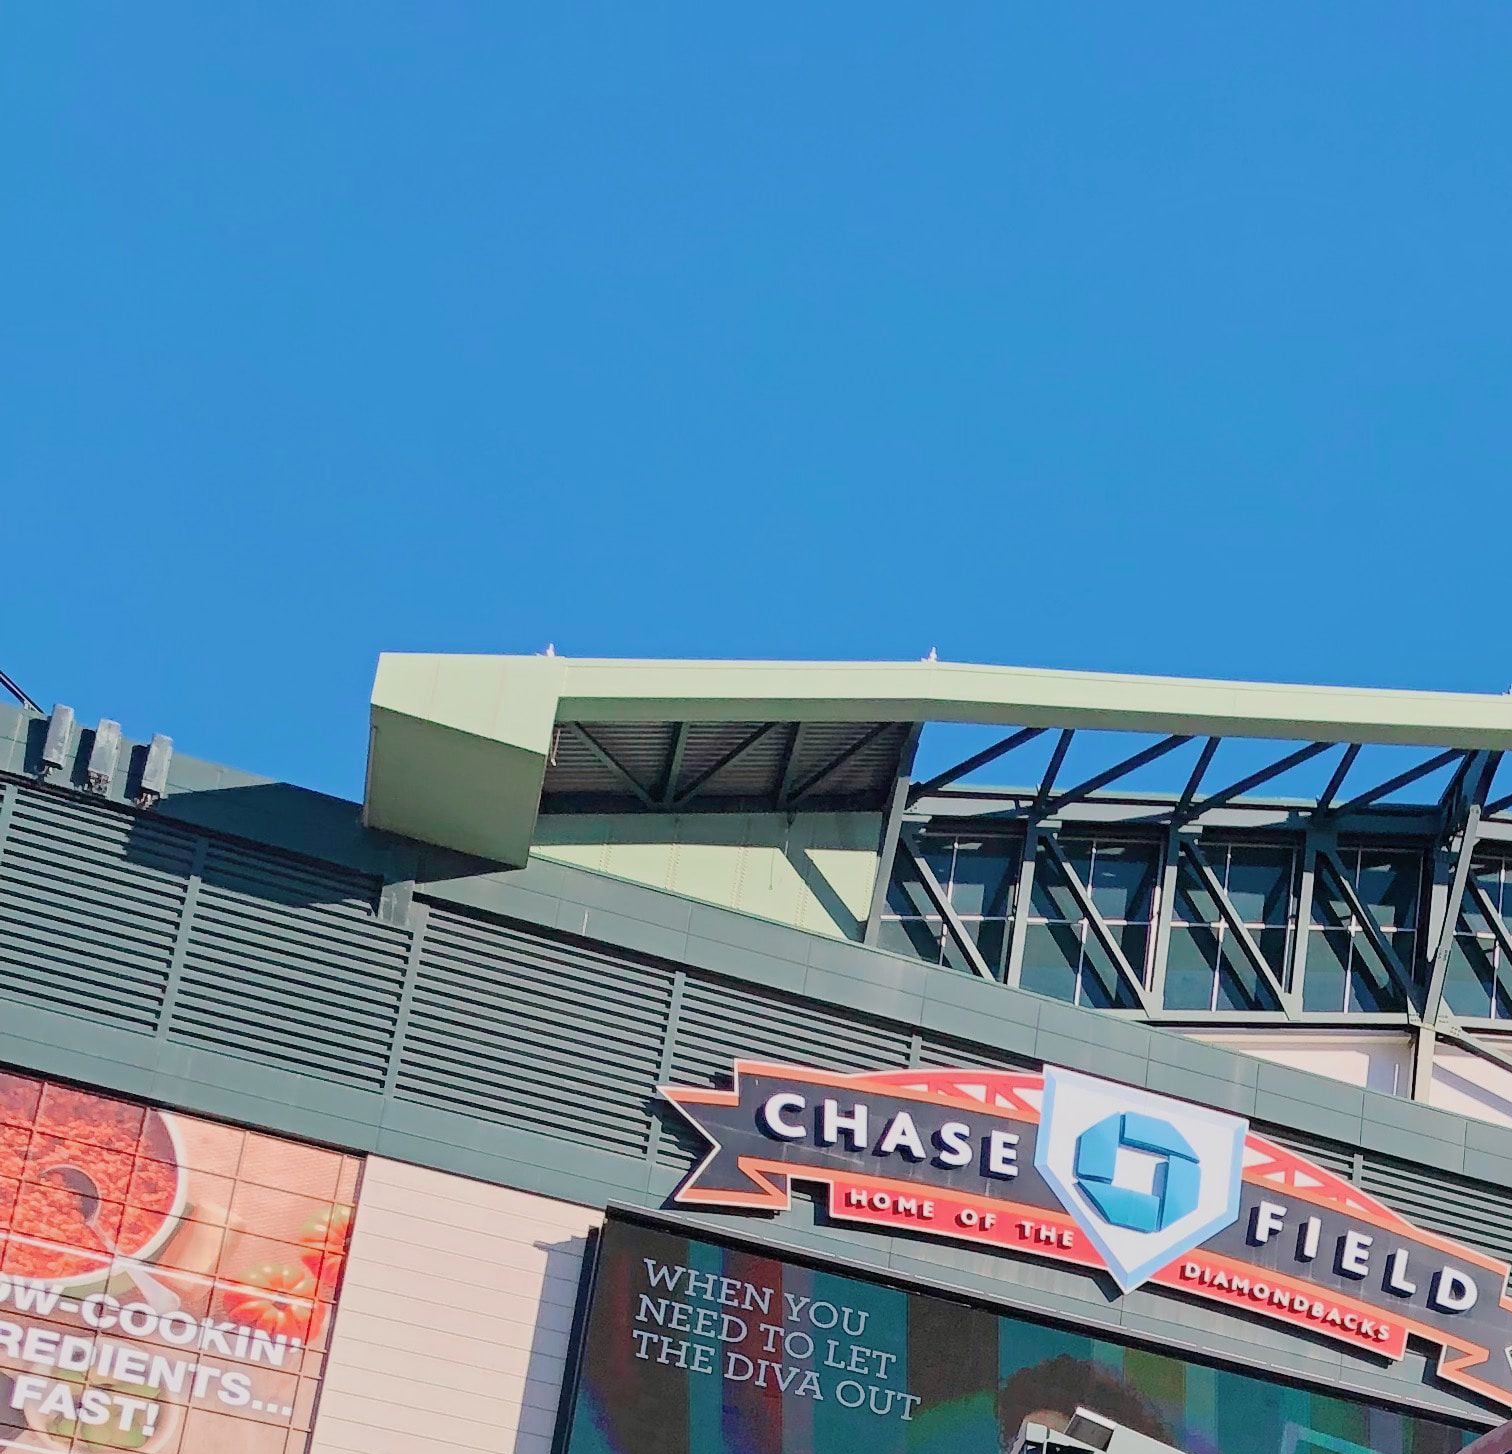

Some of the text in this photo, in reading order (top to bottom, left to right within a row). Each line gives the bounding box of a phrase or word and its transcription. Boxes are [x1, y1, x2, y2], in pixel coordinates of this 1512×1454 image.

[757, 1092, 1479, 1313] CHASE FIELD
[643, 1257, 870, 1337] WHEN YOU
[847, 1187, 1391, 1341] HOME OF THE DIAMONDBACKS
[632, 1329, 922, 1421] THE DIVA OUT
[635, 1293, 897, 1380] NEED TO LET
[9, 1374, 160, 1437] FAST!
